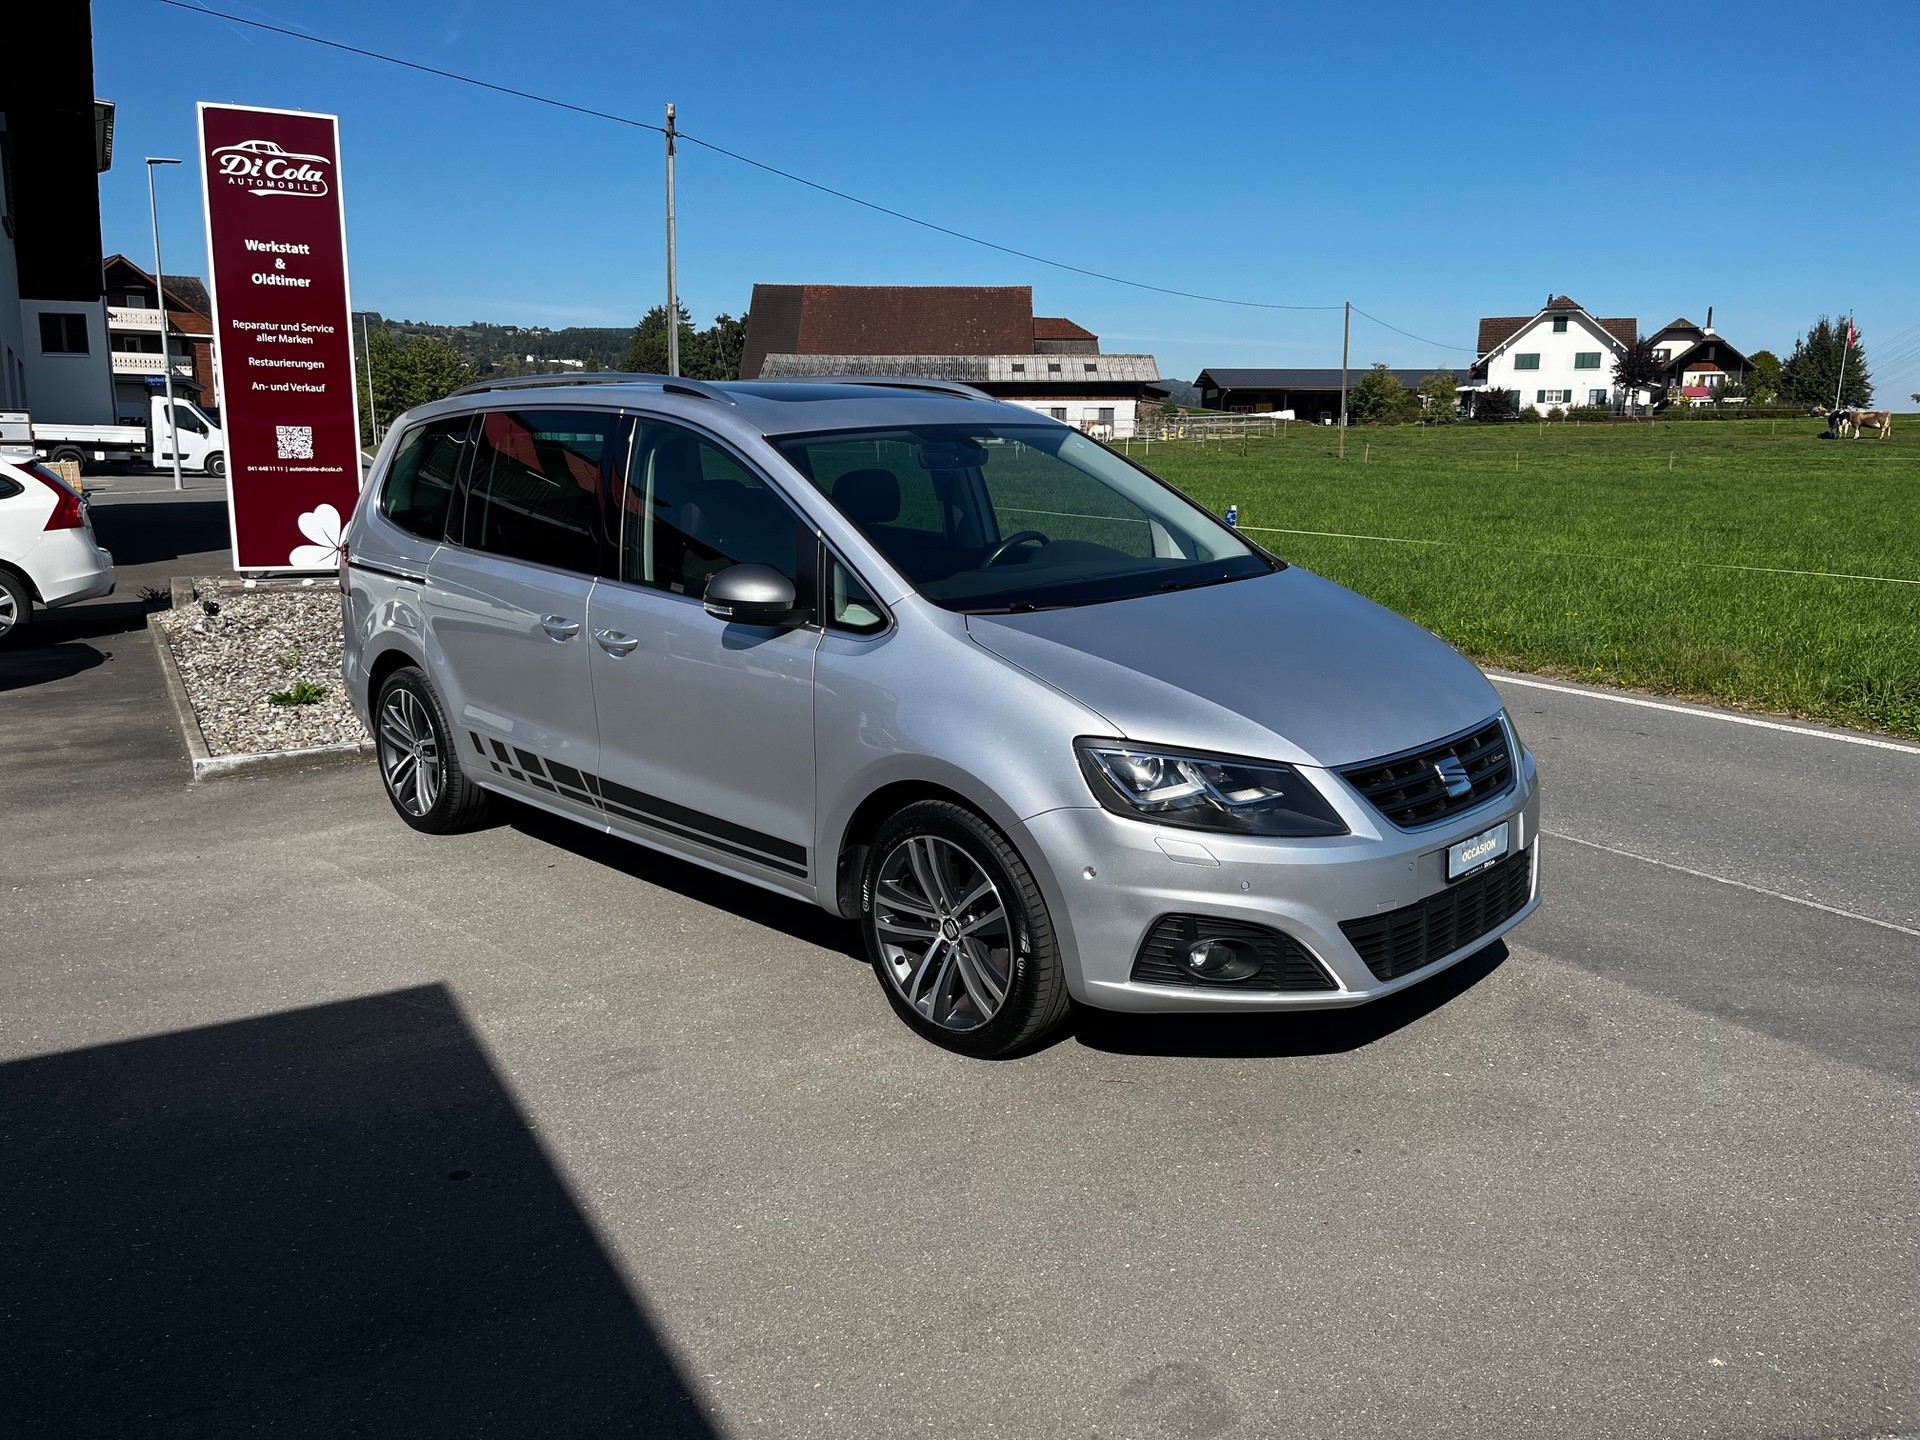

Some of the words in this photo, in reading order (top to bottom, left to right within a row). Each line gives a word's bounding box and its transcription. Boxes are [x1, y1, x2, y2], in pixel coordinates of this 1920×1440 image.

[228, 177, 319, 192] AUTOMOBILE
[244, 239, 310, 255] Werkstatt
[275, 258, 286, 270] &
[251, 273, 311, 288] Oldtimer
[232, 319, 279, 332] Reparatur
[281, 322, 299, 332] und
[301, 323, 335, 334] Service
[256, 333, 277, 343] aller
[278, 334, 314, 345] Marken
[248, 357, 325, 371] Restaurierungen
[251, 382, 269, 392] An-
[270, 382, 289, 392] und
[290, 383, 326, 393] Verkauf
[1462, 838, 1496, 862] OCCASION
